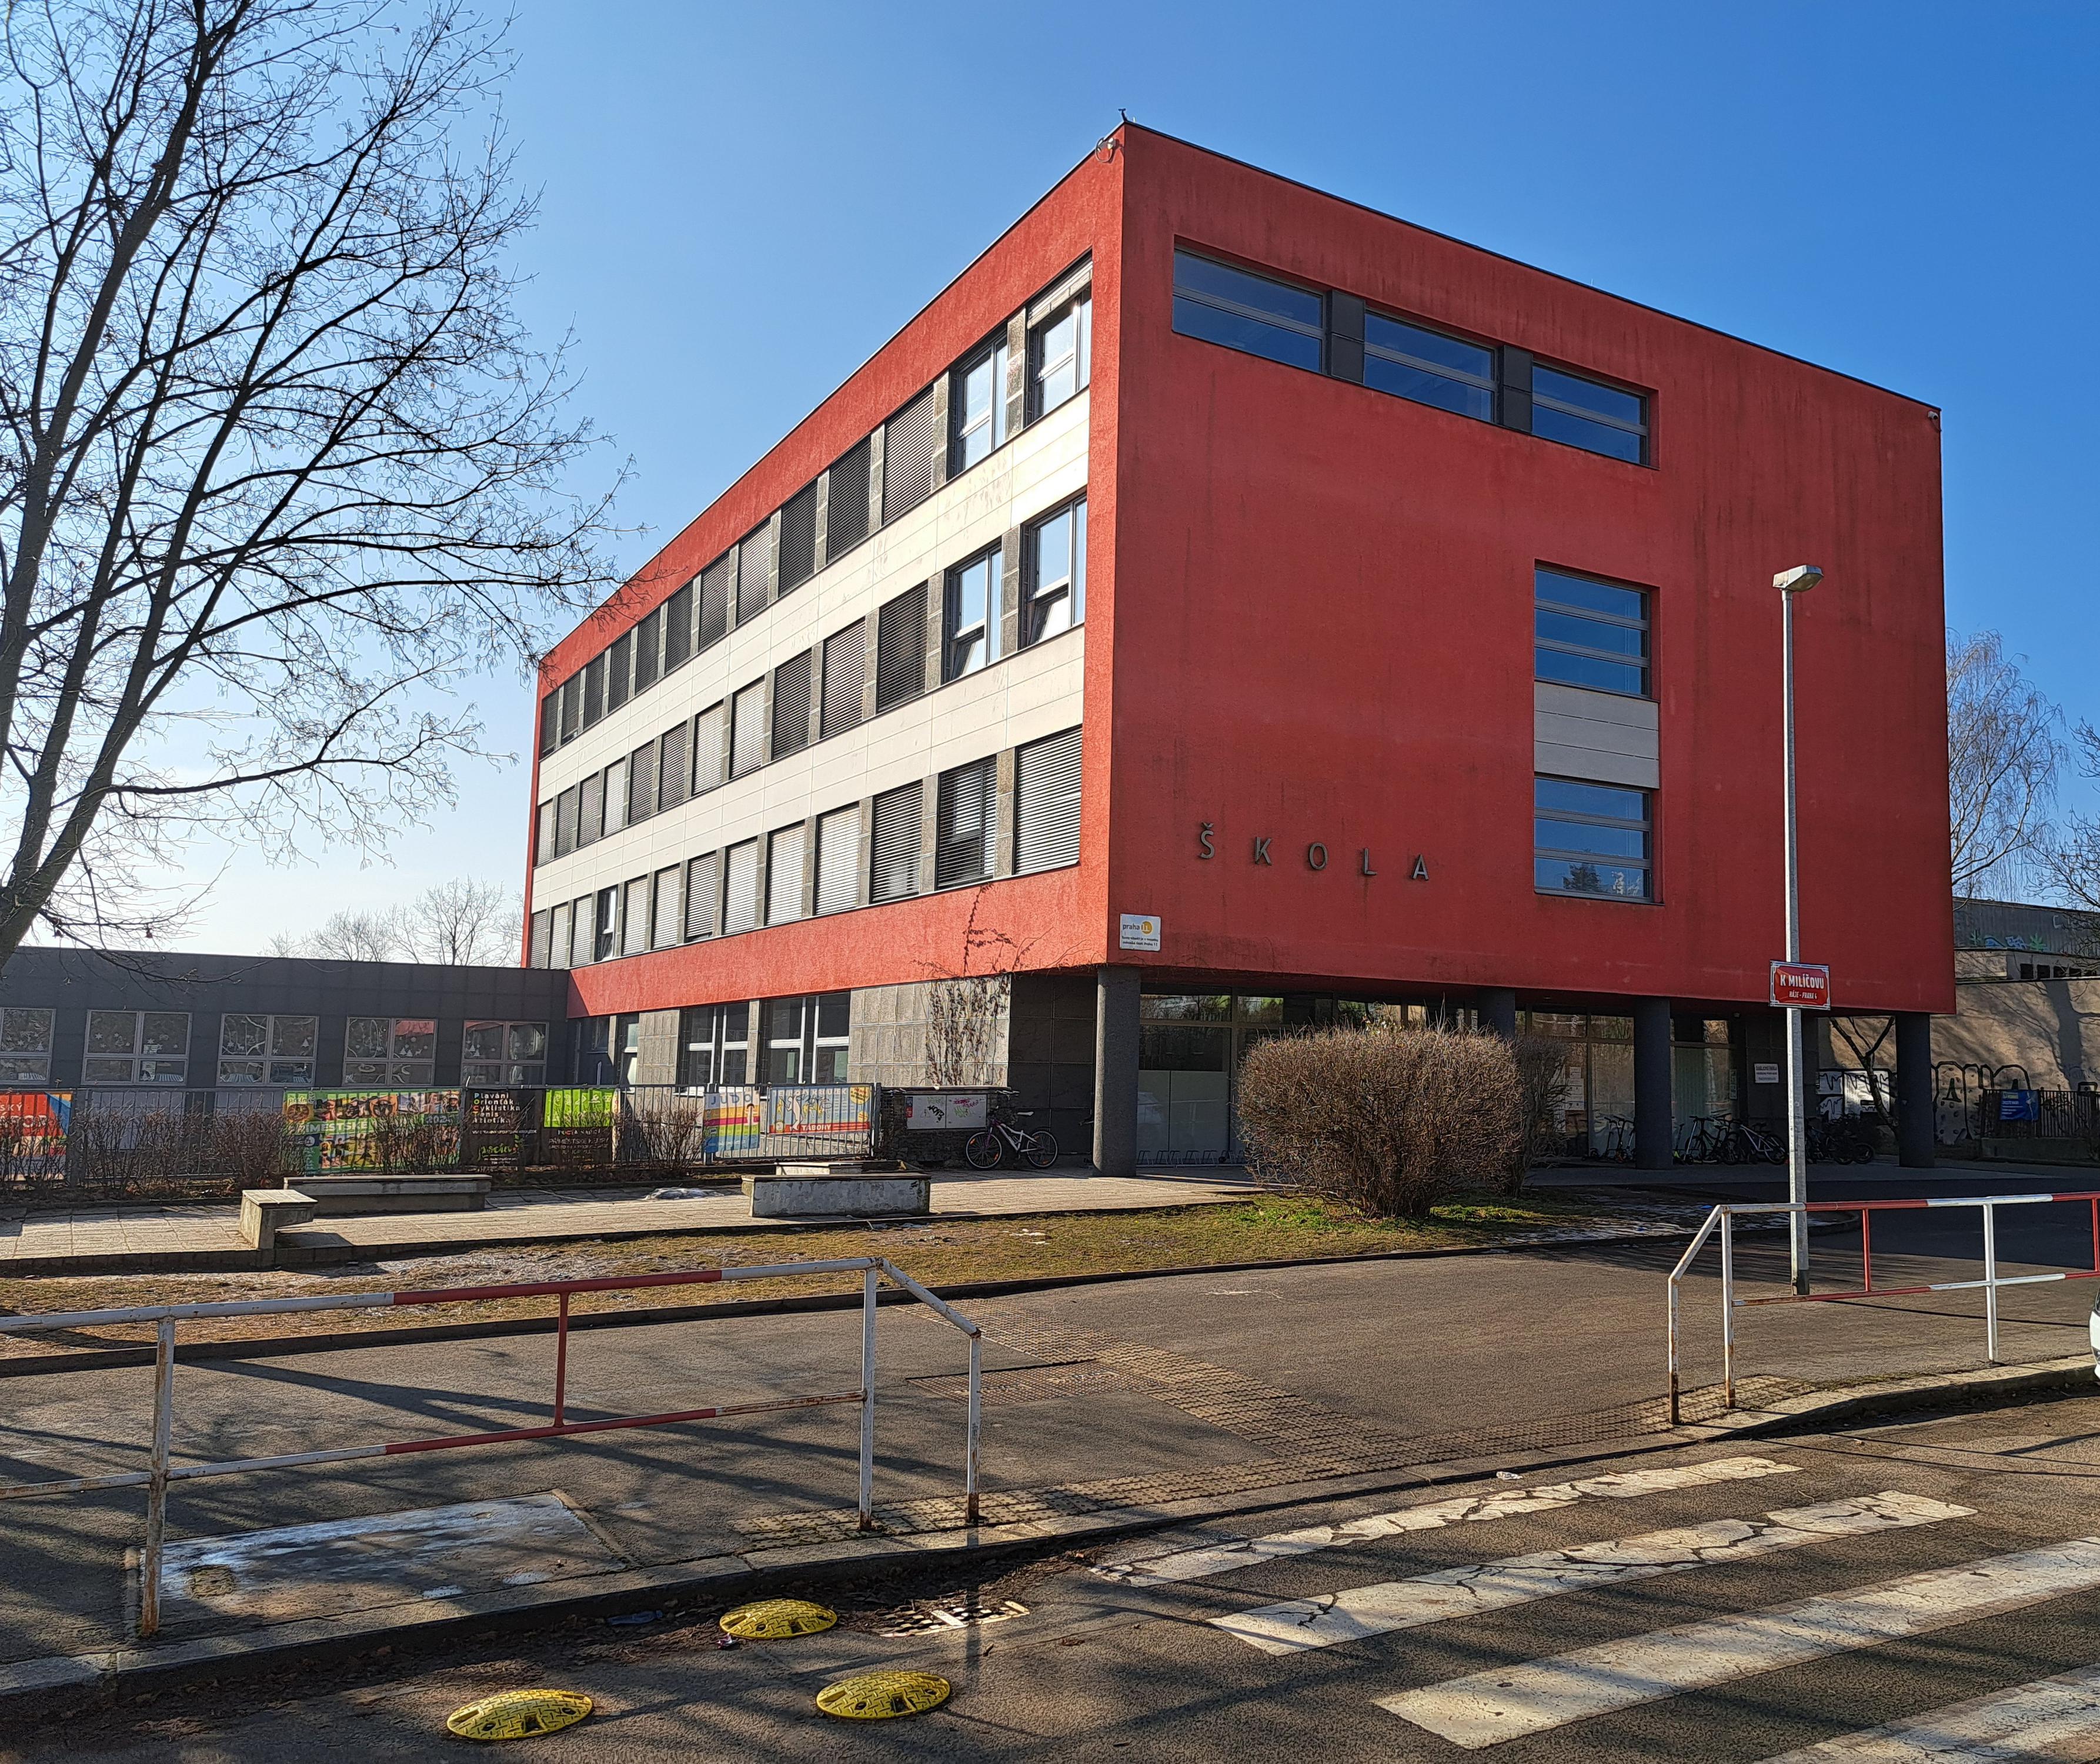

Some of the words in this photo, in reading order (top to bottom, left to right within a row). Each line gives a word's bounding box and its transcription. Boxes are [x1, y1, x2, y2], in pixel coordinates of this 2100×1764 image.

[1198, 821, 1430, 881] ŠKOLA
[1780, 974, 1786, 986] K
[1788, 973, 1824, 989] MILÍČOVU
[1789, 990, 1799, 998] HÁJE
[711, 1093, 752, 1105] JUDO
